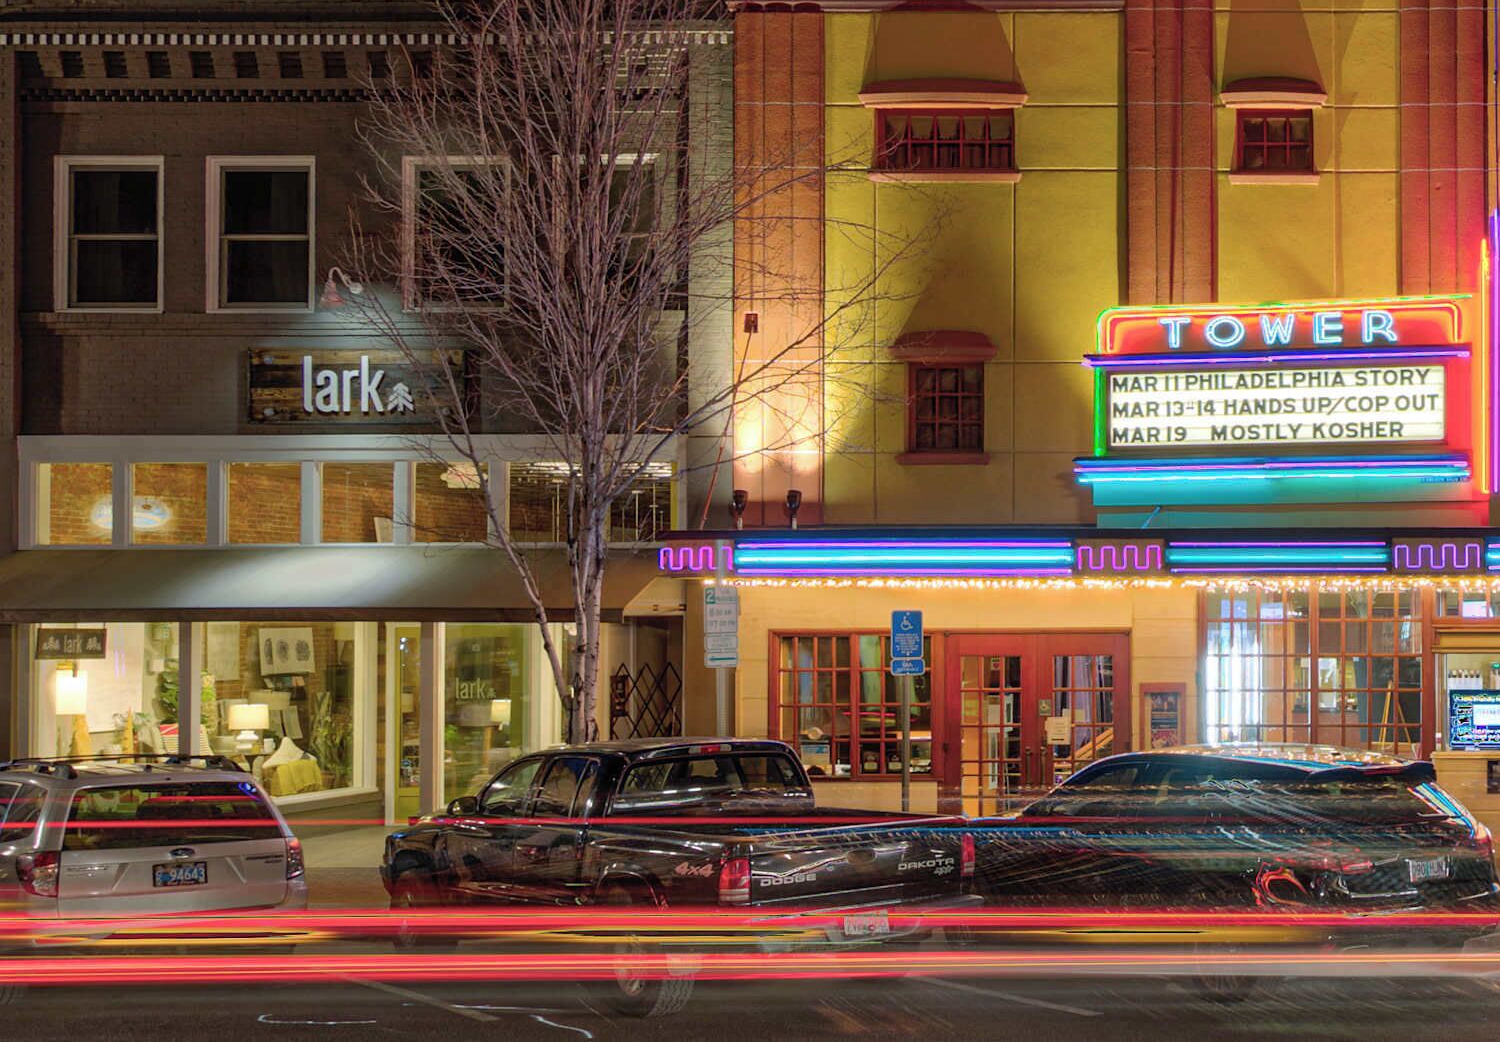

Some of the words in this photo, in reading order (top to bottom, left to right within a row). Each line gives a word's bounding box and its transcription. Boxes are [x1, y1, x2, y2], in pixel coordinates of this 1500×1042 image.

[1159, 310, 1398, 348] TOWER
[303, 355, 385, 413] lark
[1112, 376, 1158, 393] MAR
[1185, 371, 1345, 391] PHILADELPHIA
[1354, 368, 1431, 386] STORY
[1112, 401, 1160, 418] MAR
[1223, 397, 1296, 416] HANDS
[1302, 395, 1390, 415] UP/COP
[1395, 394, 1440, 411] OUT
[1112, 427, 1161, 444] MAR
[1167, 426, 1187, 442] 19
[1211, 423, 1303, 442] MOSTLY
[1312, 421, 1404, 439] KOSHER
[63, 634, 82, 654] lark
[455, 677, 486, 699] lark
[675, 861, 715, 877] 4x4
[898, 858, 955, 870] DAKOTA
[760, 873, 817, 887] DODGE
